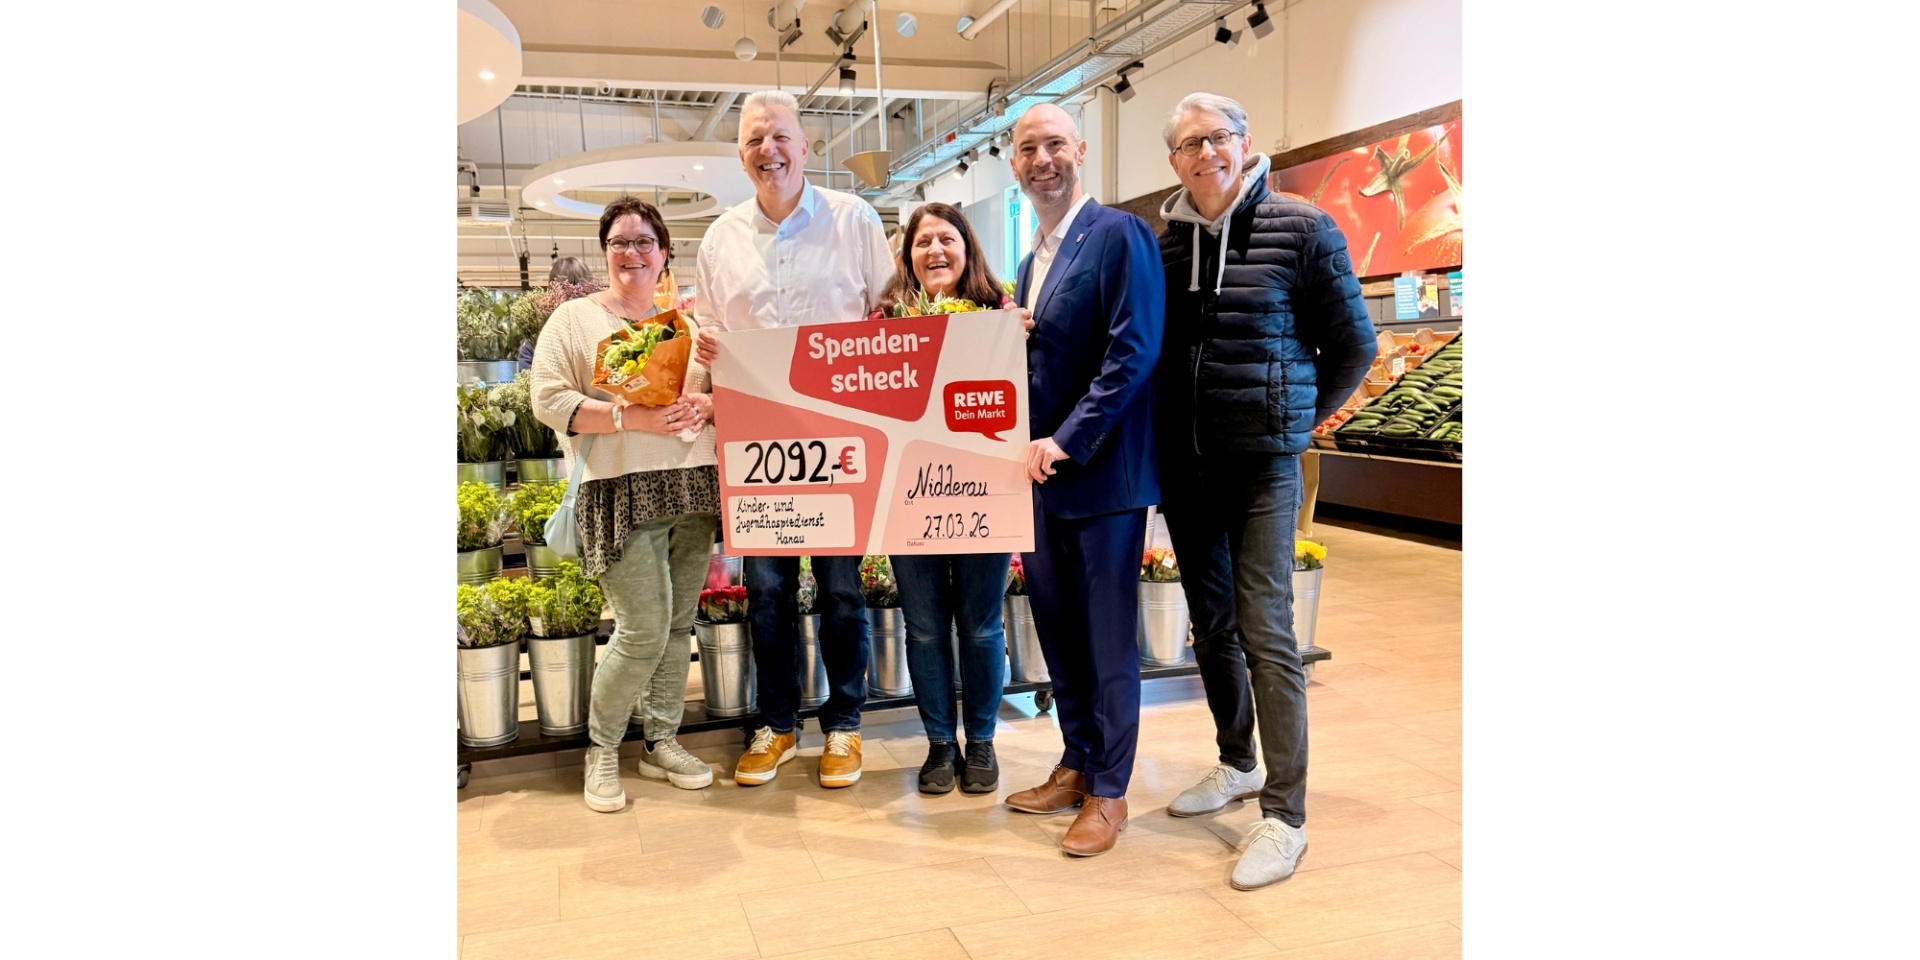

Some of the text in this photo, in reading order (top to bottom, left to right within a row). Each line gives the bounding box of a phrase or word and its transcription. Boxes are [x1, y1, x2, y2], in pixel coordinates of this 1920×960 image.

[808, 328, 930, 365] Spenden-
[831, 362, 919, 393] scheck
[954, 390, 1005, 408] REWE
[954, 408, 1006, 420] Dein Markt
[907, 462, 988, 499] Nidderau
[737, 497, 794, 513] Kinder- und
[923, 512, 990, 538] 27.03.26
[775, 531, 805, 545] Hanau
